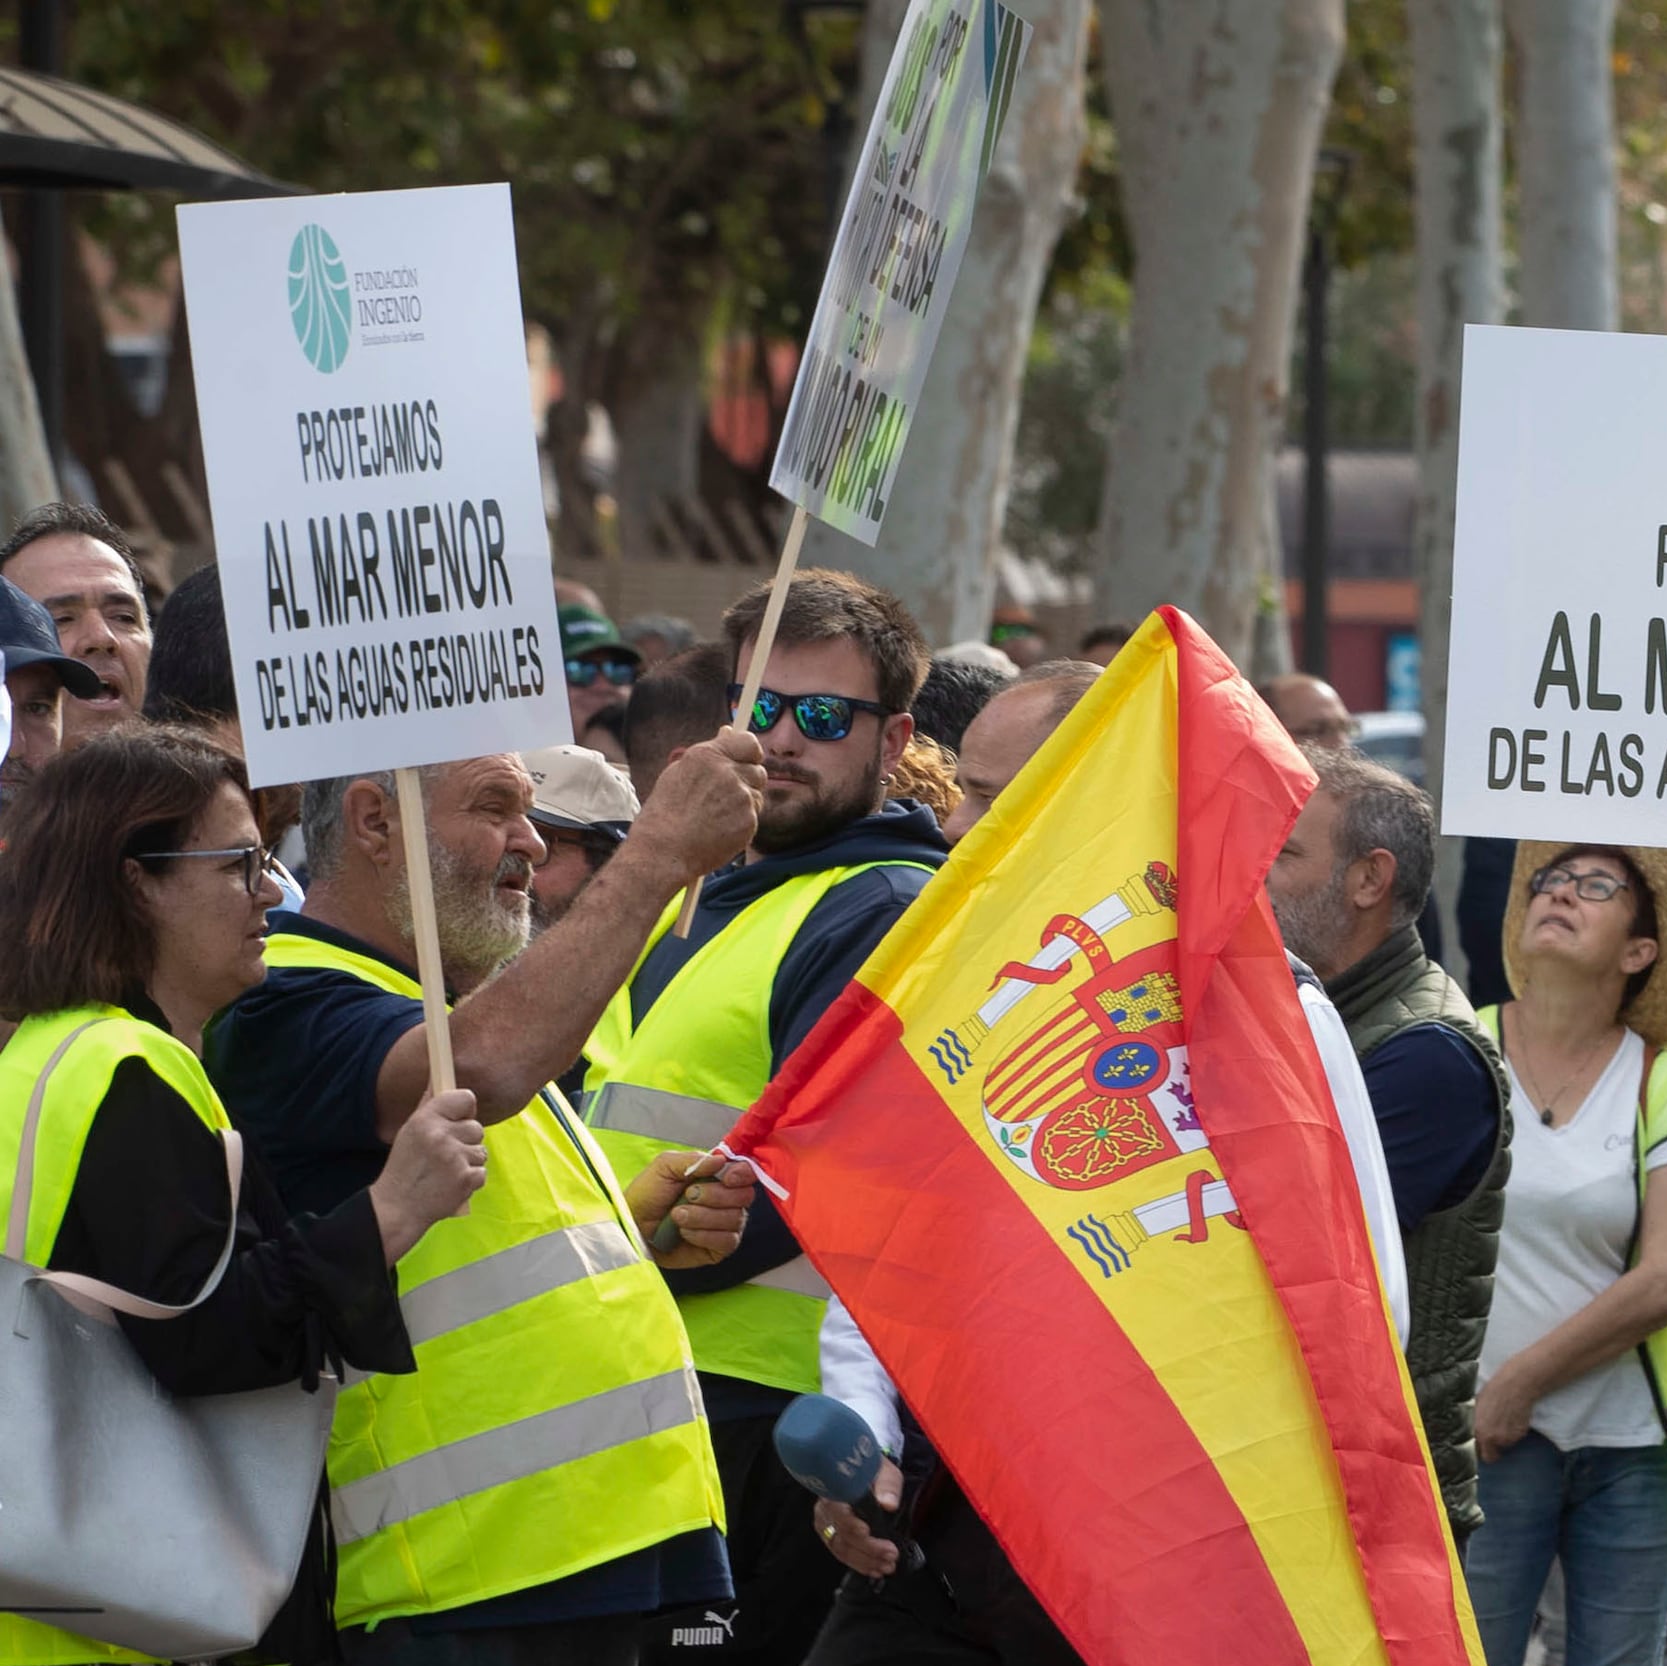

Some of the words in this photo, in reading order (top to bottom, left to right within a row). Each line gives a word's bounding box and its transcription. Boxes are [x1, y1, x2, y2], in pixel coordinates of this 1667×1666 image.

[932, 10, 968, 86] POR
[867, 193, 950, 319] DEFENSA
[358, 295, 422, 326] INGENIO
[298, 400, 441, 481] PROTEJAMOS
[827, 379, 909, 524] RURAL
[265, 521, 310, 633] AL
[309, 512, 387, 627] MAR
[387, 499, 512, 614] MENOR
[256, 658, 290, 730] DE
[289, 651, 332, 726] LAS
[337, 642, 408, 720] AGUAS
[410, 626, 544, 710] RESIDUALES
[1534, 611, 1622, 711] AL
[1488, 728, 1547, 792] DE
[1561, 731, 1643, 797] LAS
[1062, 920, 1103, 957] PLVS
[672, 1627, 723, 1646] PUMA
